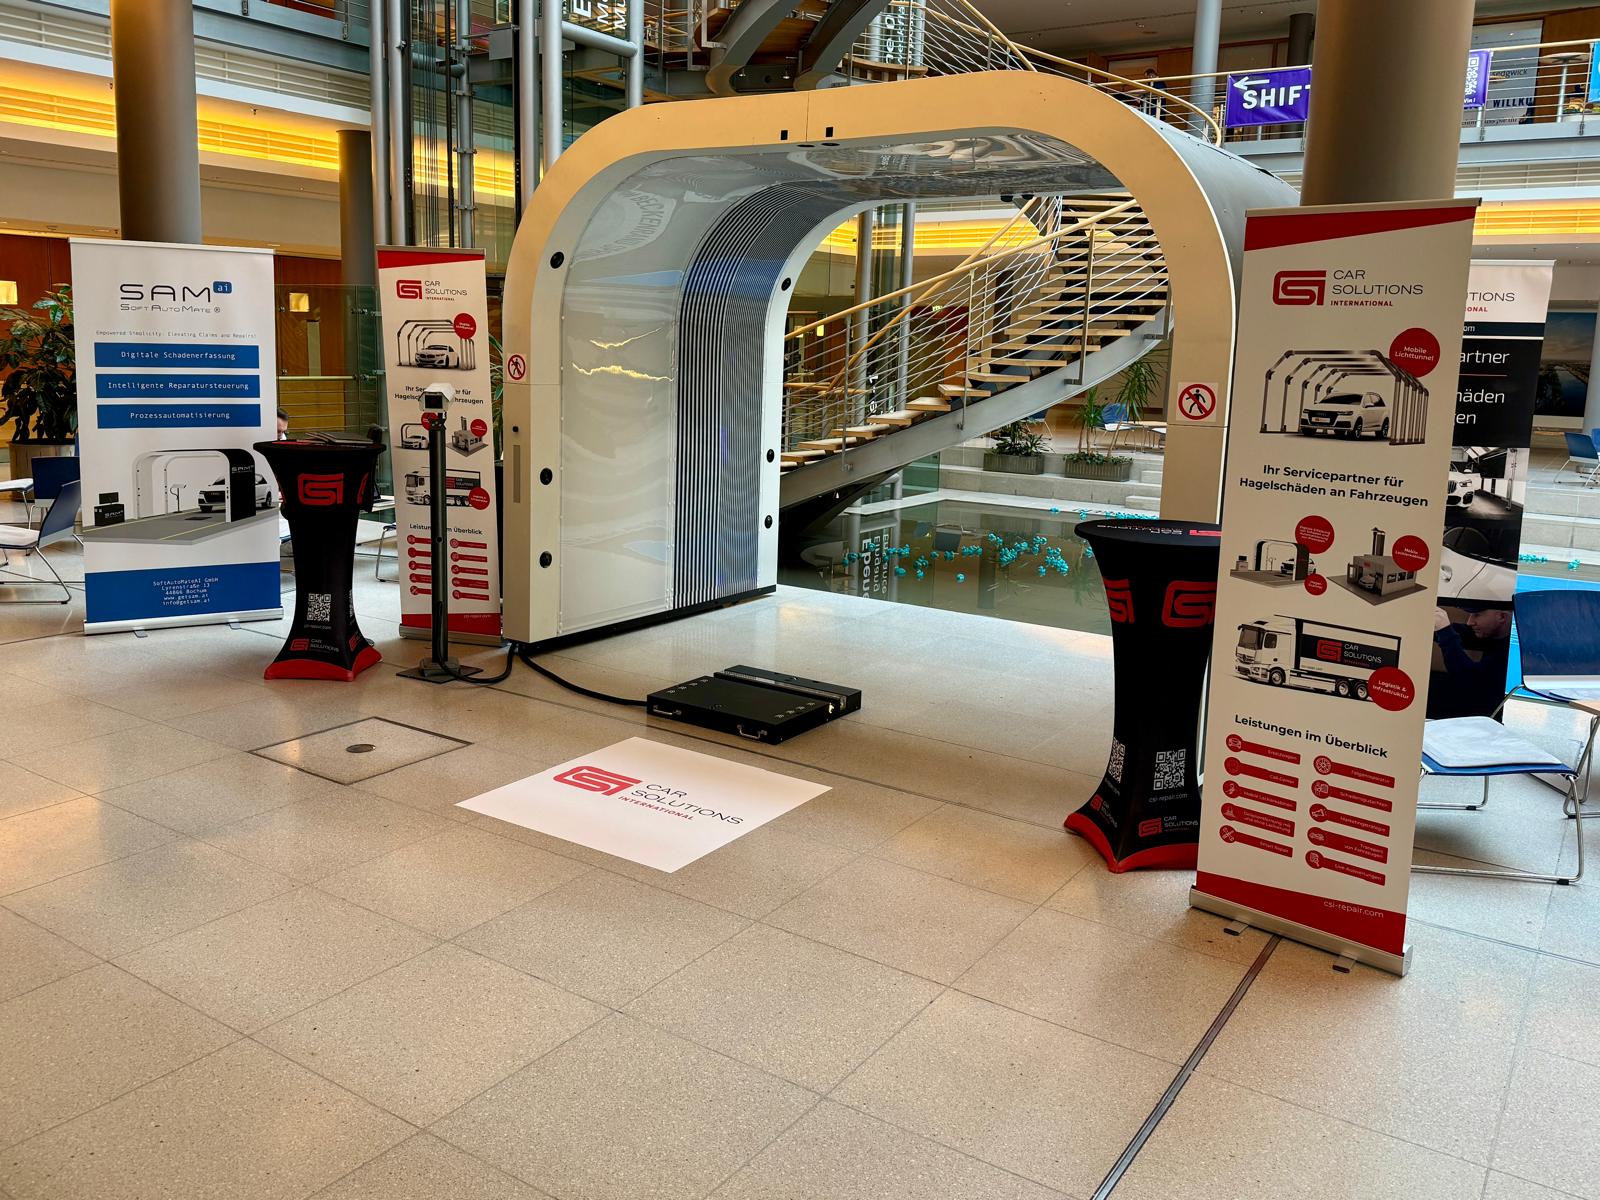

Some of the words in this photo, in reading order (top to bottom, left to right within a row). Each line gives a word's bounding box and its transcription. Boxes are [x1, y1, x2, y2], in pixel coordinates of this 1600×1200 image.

[1334, 270, 1366, 280] CAR
[120, 283, 211, 302] SAM
[424, 288, 468, 296] SOLUTIONS
[1332, 284, 1424, 296] SOLUTIONS
[1469, 292, 1516, 302] TIONS
[121, 351, 158, 360] Digitale
[163, 351, 236, 360] Schadenerfassung
[1394, 351, 1434, 361] Lichttunnel
[1403, 346, 1427, 354] Mobile
[108, 382, 164, 390] Intelligente
[168, 382, 249, 390] Reparatursteuerung
[130, 412, 230, 420] Prozessautomatisierung
[1263, 464, 1280, 475] Ihr
[1283, 467, 1380, 486] Servicepartner
[1384, 476, 1404, 488] für
[1240, 478, 1326, 496] Hagelschäden
[1330, 487, 1346, 497] an
[1350, 489, 1428, 506] Fahrzeugen
[453, 526, 482, 535] Überblick
[1344, 651, 1382, 664] SOLUTIONS
[1378, 680, 1401, 690] Logistik
[1372, 685, 1409, 699] Infrastruktur
[1235, 714, 1302, 738] Leistungen
[1305, 730, 1321, 742] im
[1325, 734, 1388, 758] Überblick
[646, 784, 687, 798] CAR
[618, 796, 694, 821] INTERNATIONAL
[631, 790, 744, 825] SOLUTIONS
[1324, 900, 1384, 918] csi-repair.com
